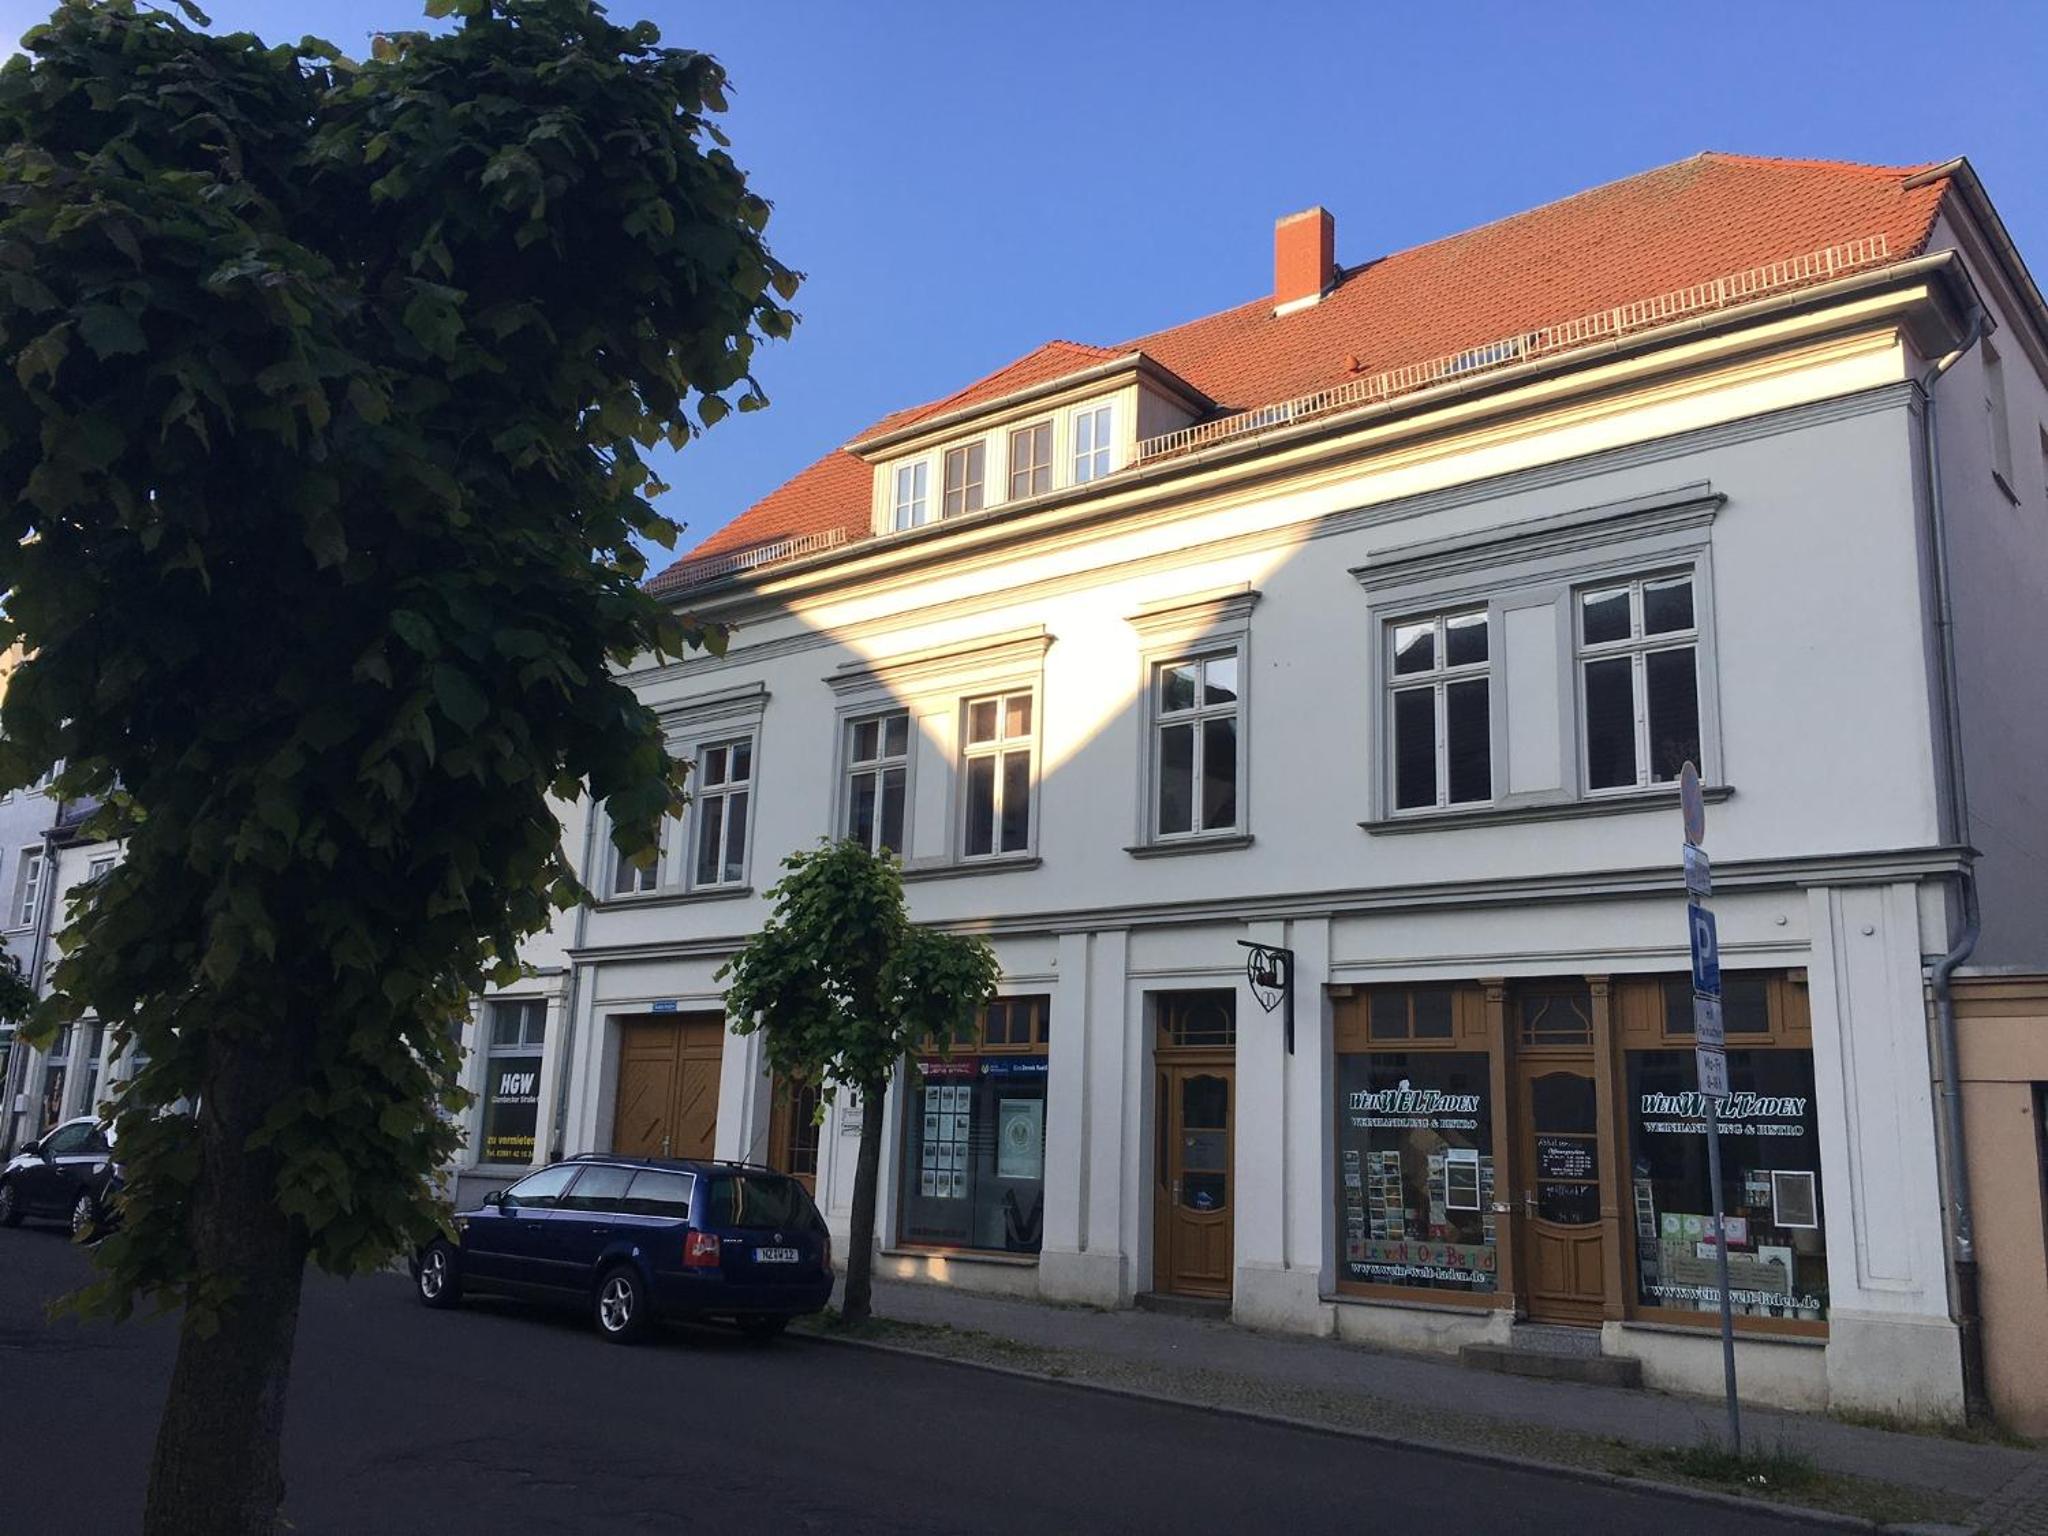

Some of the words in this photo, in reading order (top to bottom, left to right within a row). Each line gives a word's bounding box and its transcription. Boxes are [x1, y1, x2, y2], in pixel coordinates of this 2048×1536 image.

[1696, 917, 1712, 981] P
[500, 1073, 535, 1095] HGW
[1744, 1124, 1755, 1136] &
